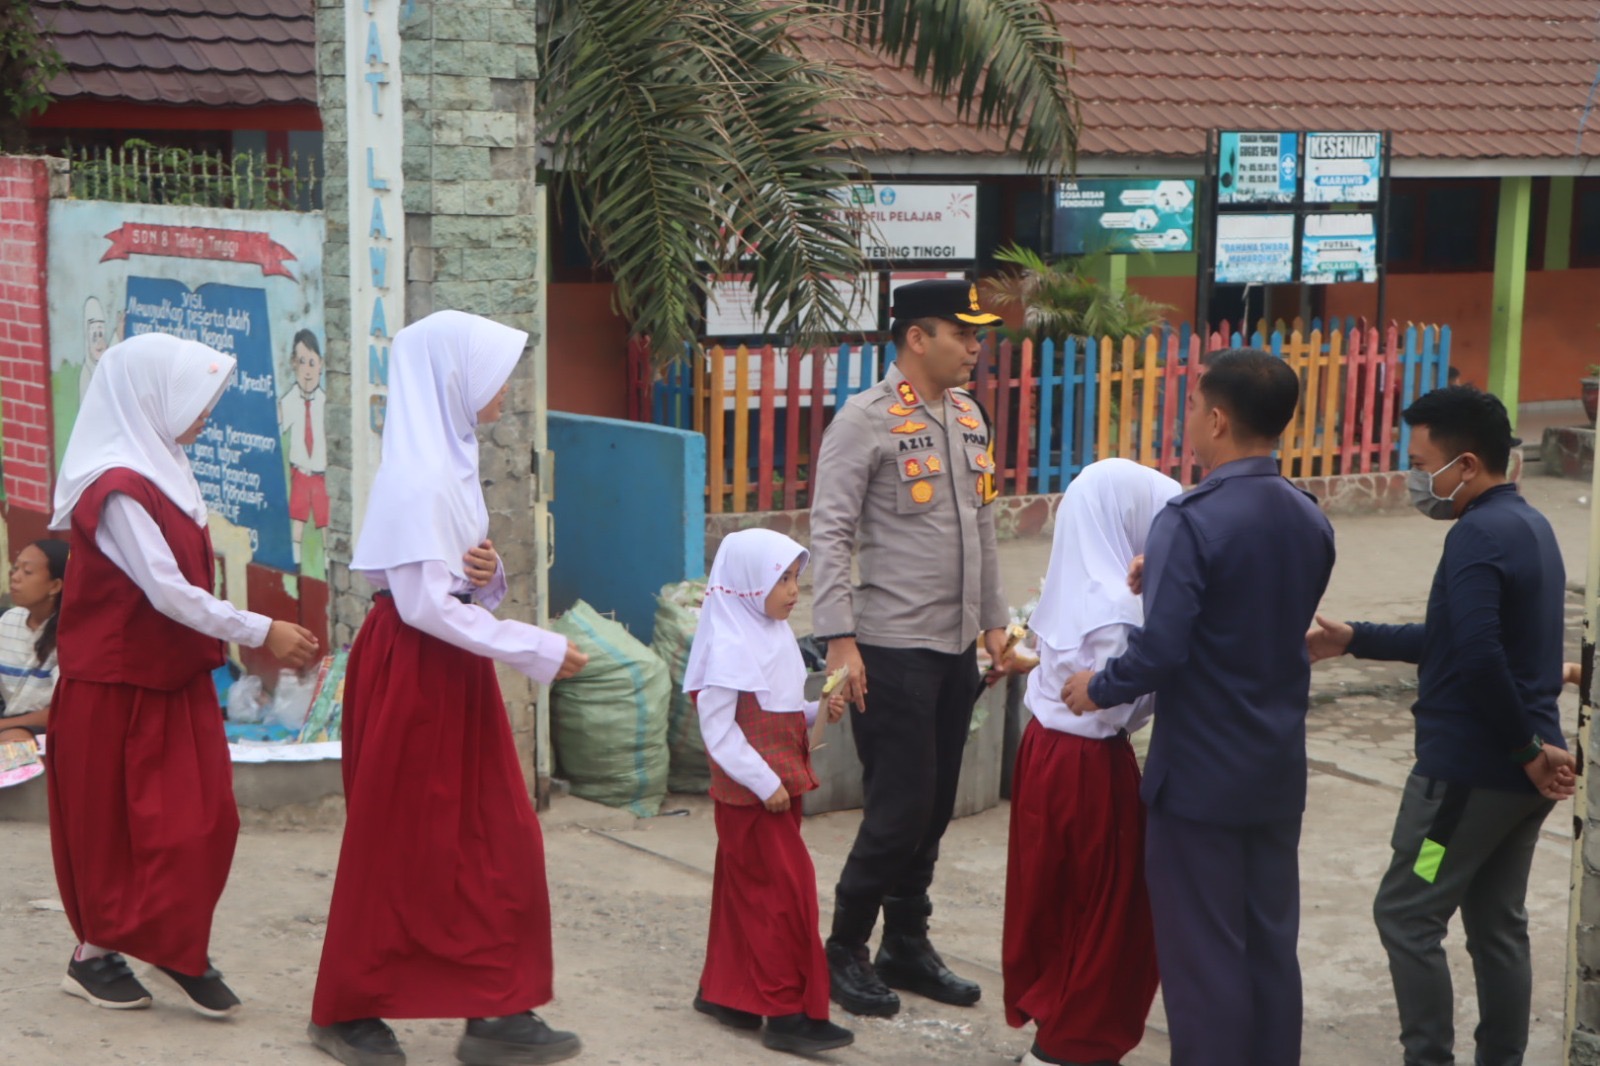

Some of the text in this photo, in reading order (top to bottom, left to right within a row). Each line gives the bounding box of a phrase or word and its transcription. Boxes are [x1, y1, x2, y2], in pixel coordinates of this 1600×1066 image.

[1310, 135, 1376, 158] KESENIAN
[1320, 175, 1364, 185] MARAWIS
[1060, 183, 1078, 191] TGA
[1060, 191, 1105, 199] DOSA BESAR
[1060, 200, 1105, 208] PENDIDIKAN
[889, 211, 942, 222] PELAJAR
[132, 229, 157, 244] SDN
[161, 230, 169, 247] 8
[207, 235, 239, 258] Tinggi
[865, 246, 956, 258] TEBING TINGGI
[366, 147, 389, 434] LAWANG
[187, 308, 225, 331] peserta
[899, 436, 934, 451] AZIZ
